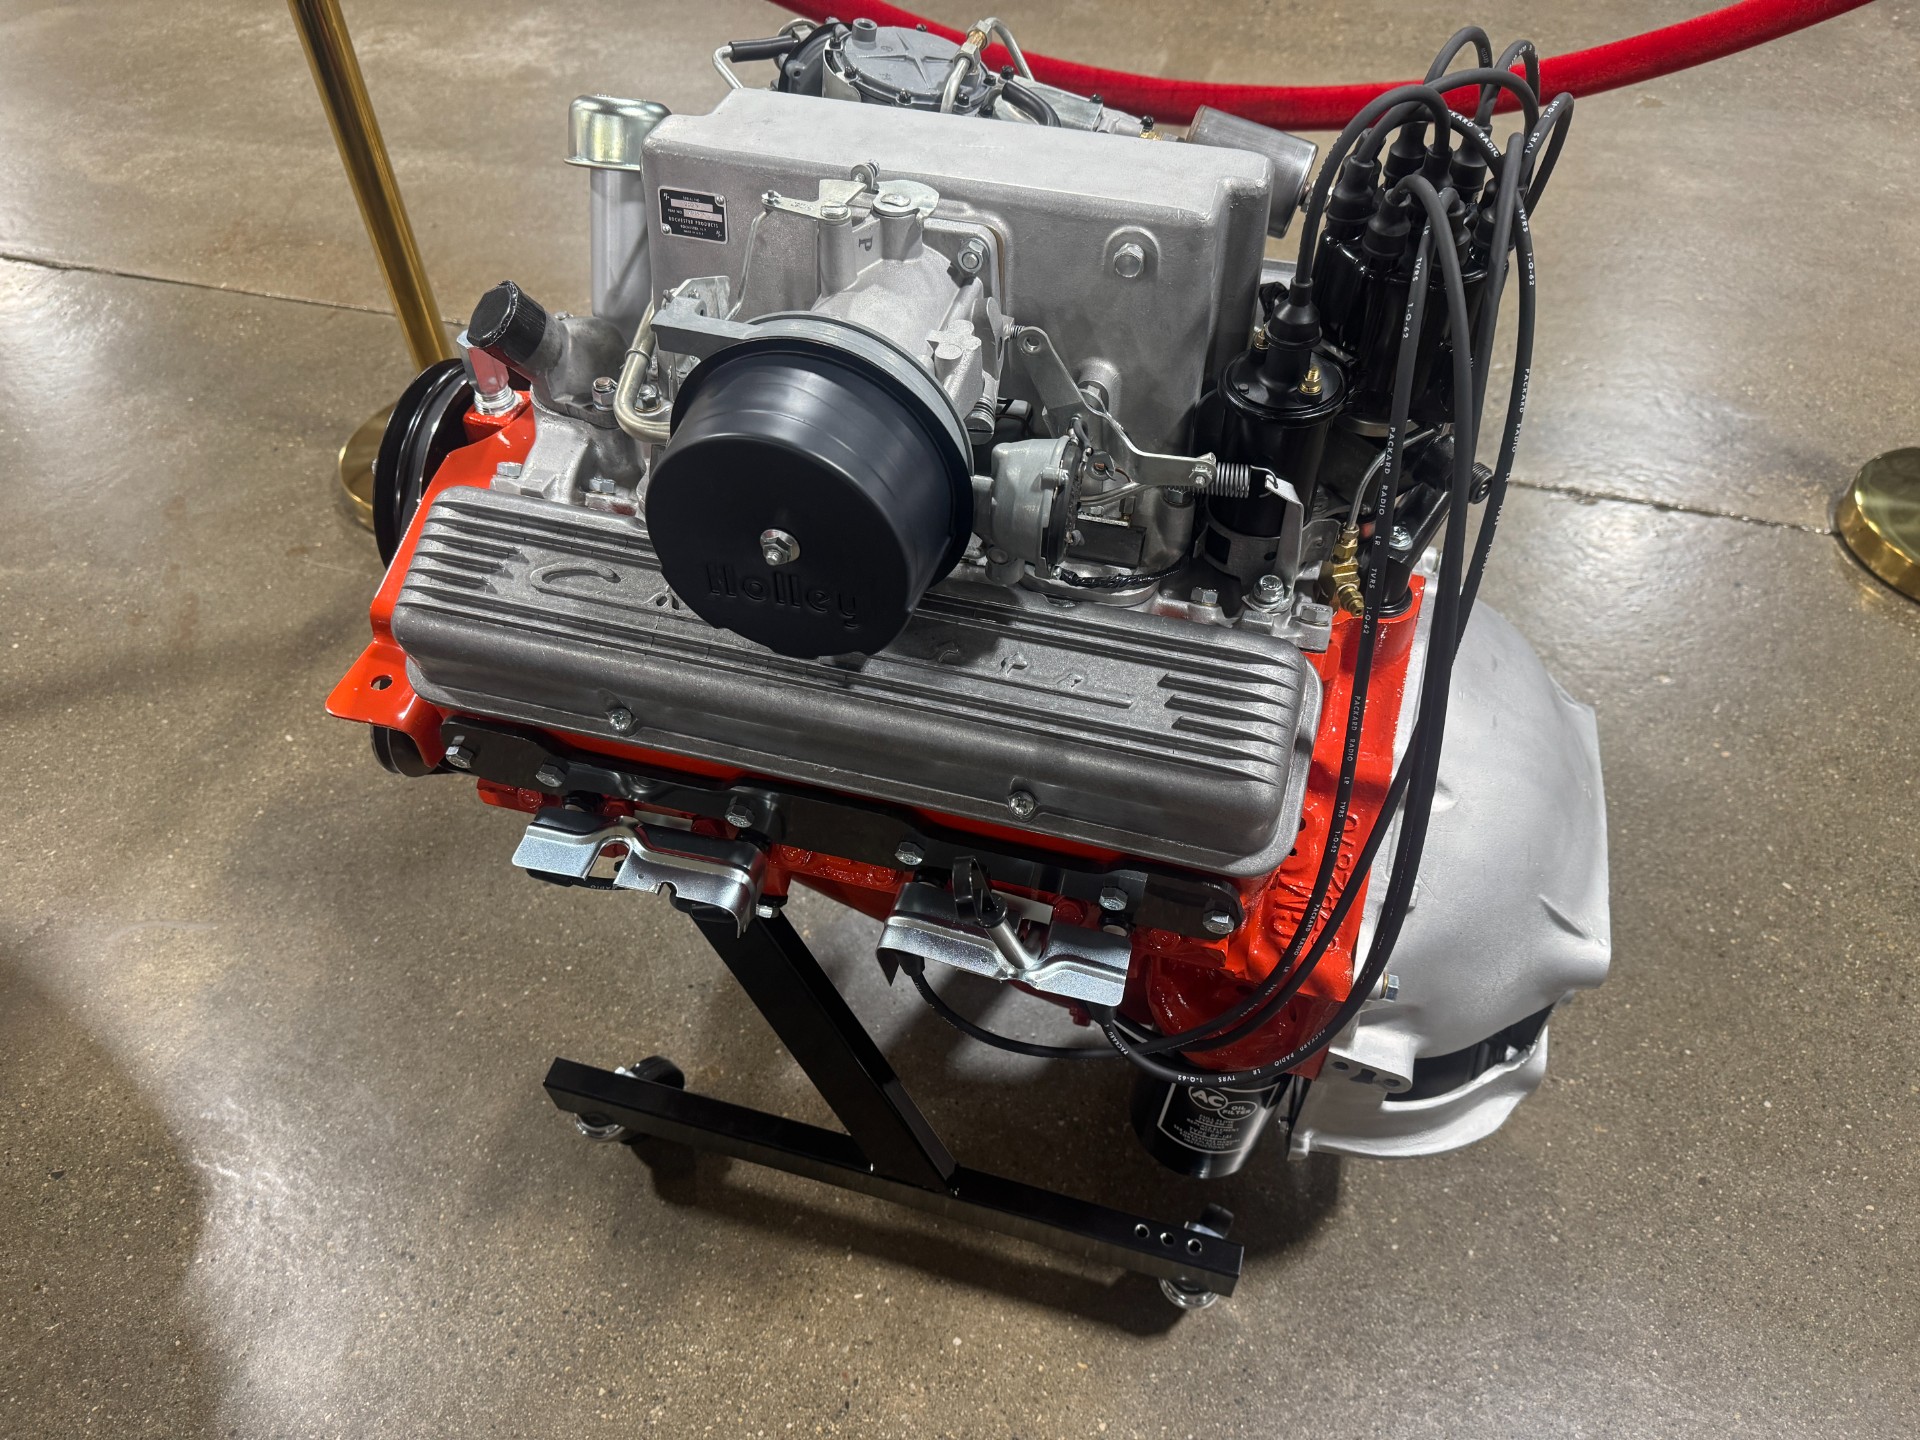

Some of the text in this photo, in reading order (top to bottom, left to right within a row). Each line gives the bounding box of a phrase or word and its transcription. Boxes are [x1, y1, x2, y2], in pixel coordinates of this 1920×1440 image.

[1478, 132, 1500, 158] RADIO
[1524, 132, 1540, 154] TVRS
[1518, 208, 1535, 286] TVRS 1-Q-62
[1412, 256, 1423, 282] TVRS
[1402, 302, 1414, 339] 1-Q-62
[1519, 368, 1530, 413] PACKARD
[1512, 423, 1521, 453] RADIO
[1362, 426, 1396, 635] PACKARD RADIO LR TVRS 1-Q-62
[706, 562, 861, 630] Holley
[1349, 695, 1361, 731] PACKARD
[1346, 738, 1356, 762] RADIO
[1338, 801, 1347, 818] TVRS
[1305, 904, 1321, 932] PACKARD
[1293, 936, 1306, 956] RADIO
[1107, 1031, 1129, 1056] PACKARD
[1274, 1052, 1294, 1067] RADIO
[1177, 1074, 1203, 1083] 1-Q-62
[1218, 1075, 1235, 1083] TVRS
[1192, 1090, 1225, 1108] AC
